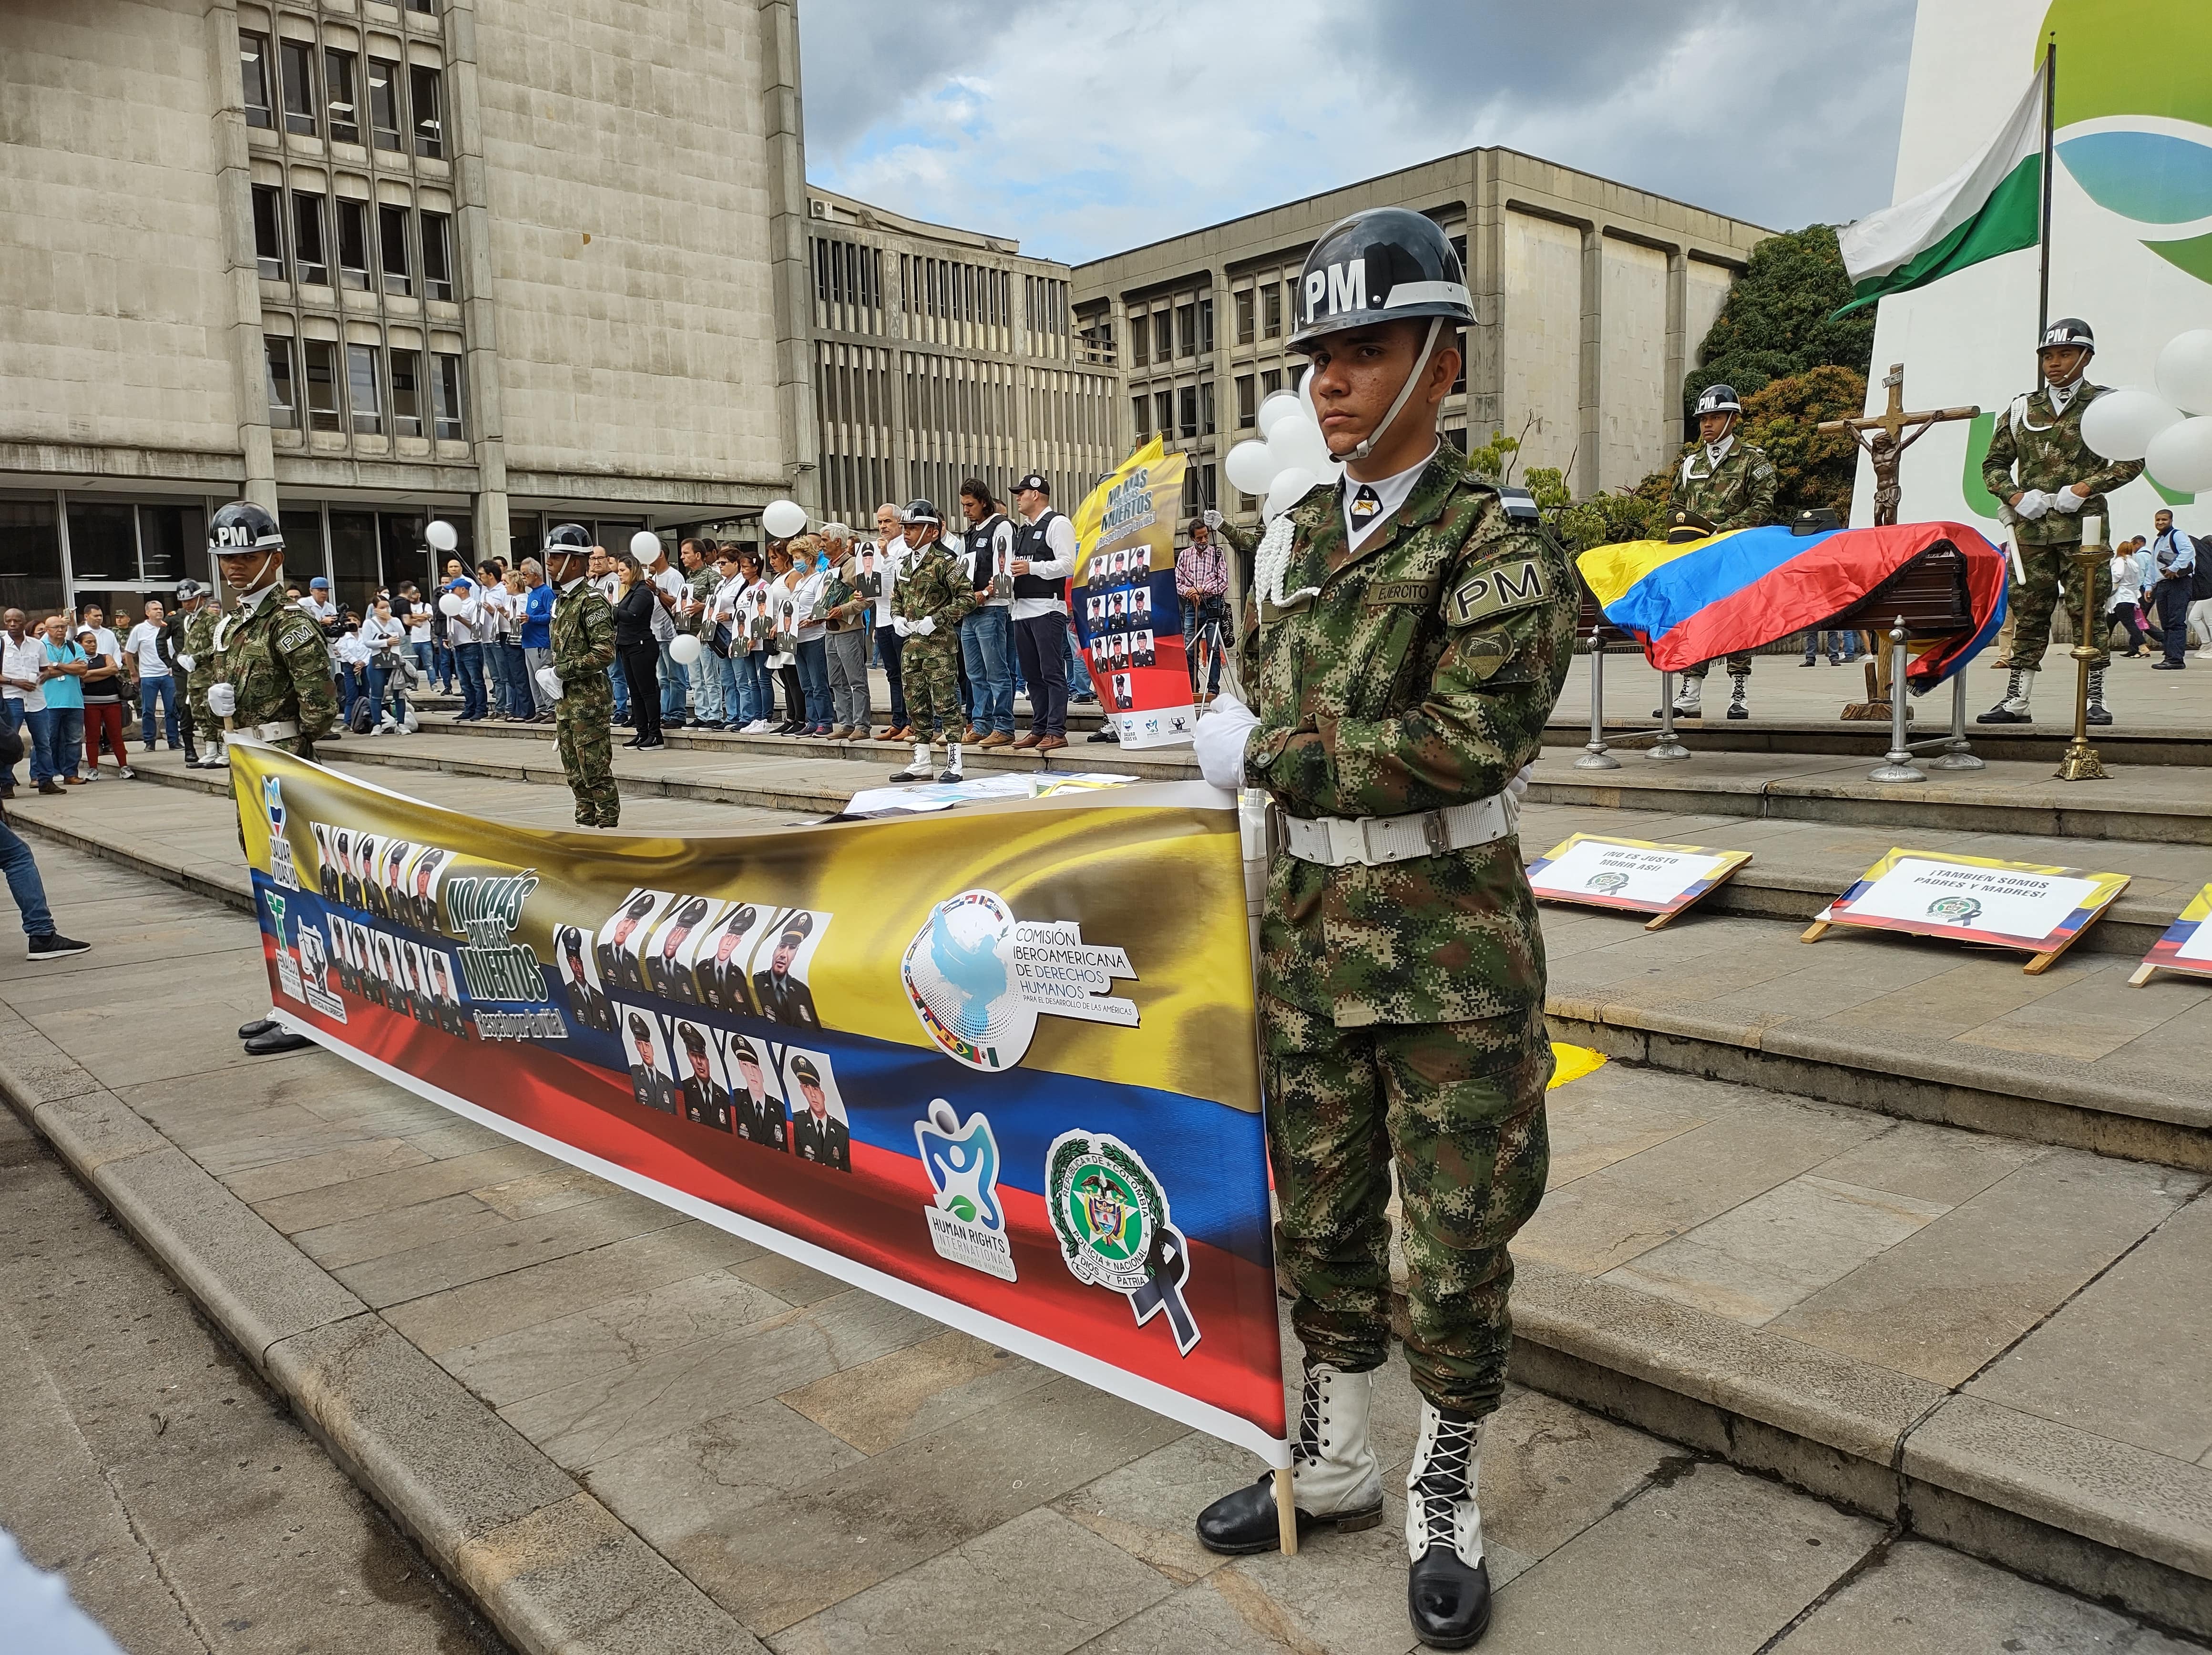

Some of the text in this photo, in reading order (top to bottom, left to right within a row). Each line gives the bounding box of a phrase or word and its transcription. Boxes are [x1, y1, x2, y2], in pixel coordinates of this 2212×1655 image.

[1306, 259, 1366, 324] PM
[2046, 328, 2068, 344] PM
[1699, 396, 1715, 410] PM
[1754, 463, 1773, 479] PM
[1106, 466, 1148, 509] NO MÁS
[1363, 490, 1369, 498] 4
[901, 510, 911, 521] PM
[1100, 490, 1152, 533] MUERTOS
[218, 526, 248, 547] PM
[1121, 523, 1132, 539] por
[1132, 520, 1139, 531] la
[948, 564, 964, 583] PM
[1377, 585, 1429, 600] EJERCITO
[1454, 562, 1544, 620] PM
[586, 610, 607, 626] PM
[280, 624, 314, 651] PM
[269, 838, 291, 864] SALVAR
[1640, 855, 1679, 864] JUSTO
[272, 859, 298, 889] VIDAS YA
[1599, 859, 1636, 868] MORIR
[1913, 877, 1966, 888] PADRES
[1981, 885, 2047, 898] MADRES!
[1929, 870, 2050, 889] ¡TAMBIÉN SOMOS
[446, 868, 539, 933] NO MÁS
[1016, 928, 1075, 947] COMISIÓN
[1013, 945, 1126, 969] IBEROAMERICANA
[456, 943, 549, 1002] MUERTOS
[1015, 964, 1104, 983] DE DERECHOS
[1019, 980, 1084, 999] HUMANOS
[1023, 995, 1037, 1003] PARA
[1045, 997, 1081, 1009] DESARROLLO
[1091, 1003, 1101, 1011] LAS
[1103, 1004, 1132, 1016] AMÉRICAS
[1063, 1155, 1148, 1218] REPUBLICA DE COLOMBIA
[932, 1216, 1005, 1253] HUMAN RIGHTS
[935, 1232, 1010, 1268] INTERNATIONAL
[1073, 1230, 1147, 1271] POLICIA NACIONAL
[939, 1246, 1012, 1277] ONG DERECHOS HUMANOS
[1080, 1257, 1145, 1286] DIOS Y PATRIA
